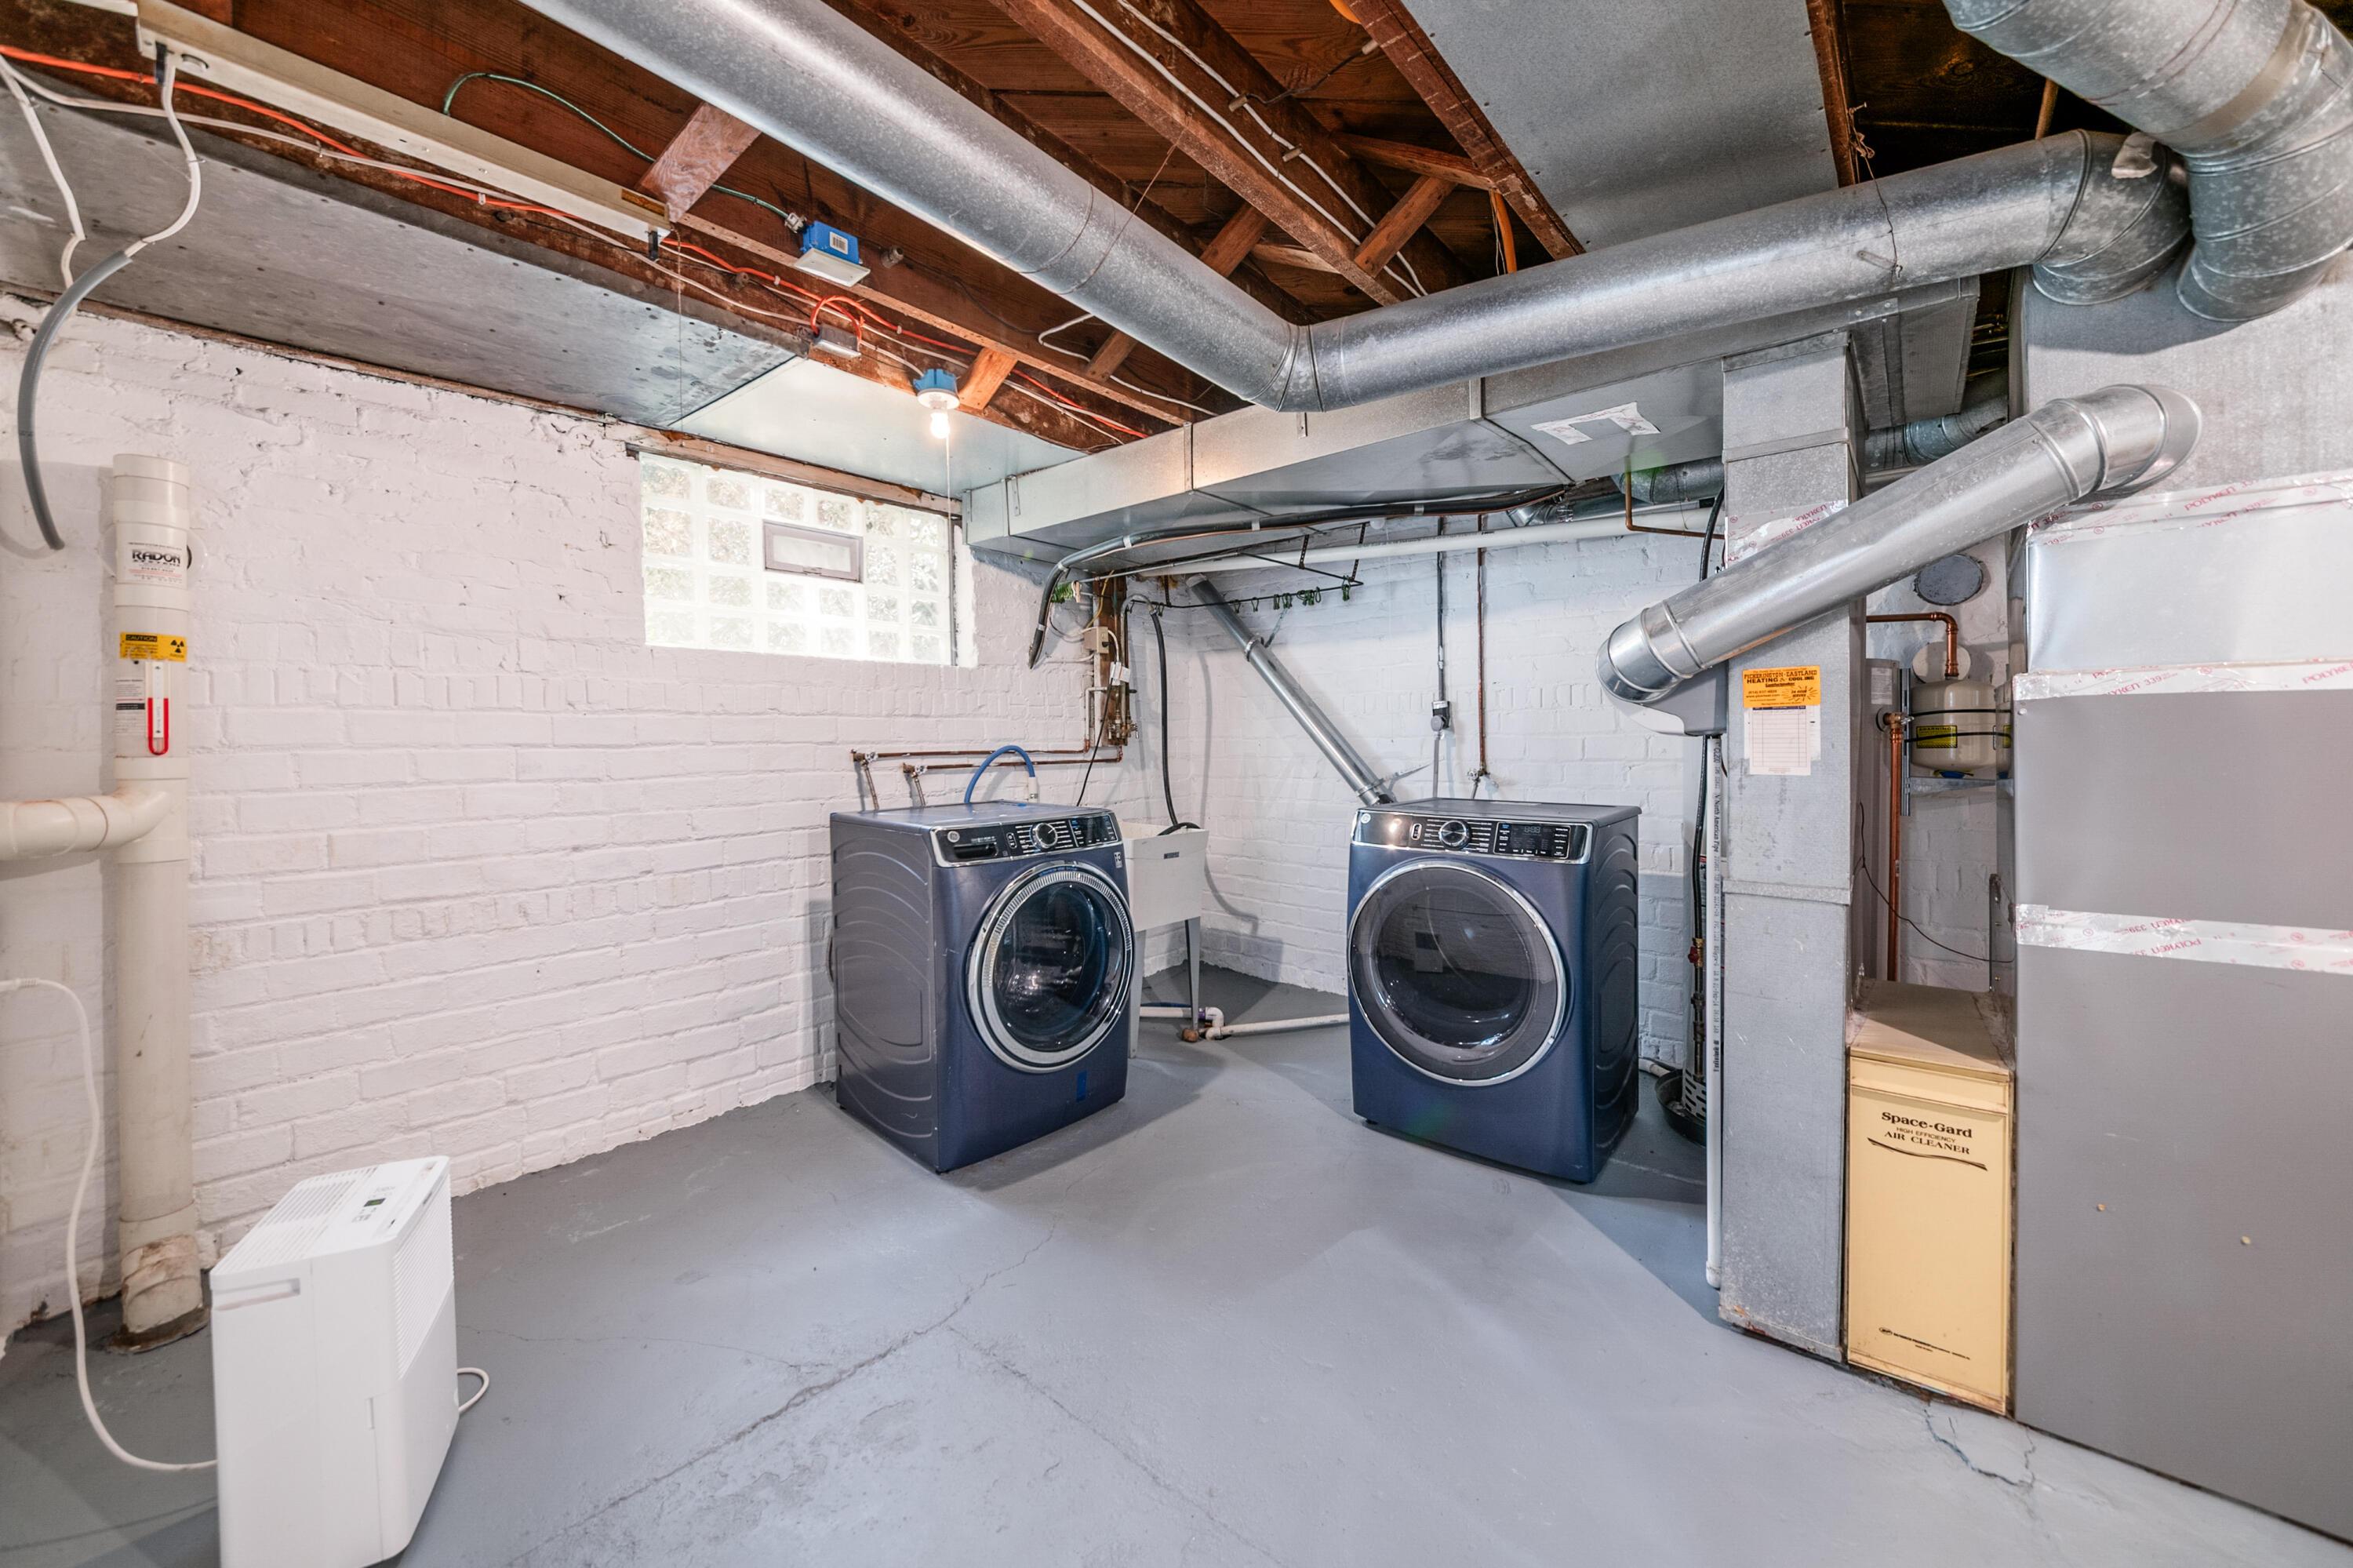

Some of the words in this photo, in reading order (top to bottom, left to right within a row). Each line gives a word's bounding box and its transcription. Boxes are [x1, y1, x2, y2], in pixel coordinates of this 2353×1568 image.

[2184, 486, 2236, 511] POLYKEN
[132, 550, 180, 564] RADON
[2144, 675, 2162, 686] 339
[1711, 841, 1720, 852] Pipe
[2151, 938, 2202, 955] POLYKEN
[1882, 1111, 1973, 1138] Space-Gard
[1884, 1131, 1905, 1141] AIR
[1911, 1137, 1970, 1155] CLEANER
[1897, 1126, 1914, 1135] HIGH
[1915, 1130, 1956, 1143] EFFICIENCY
